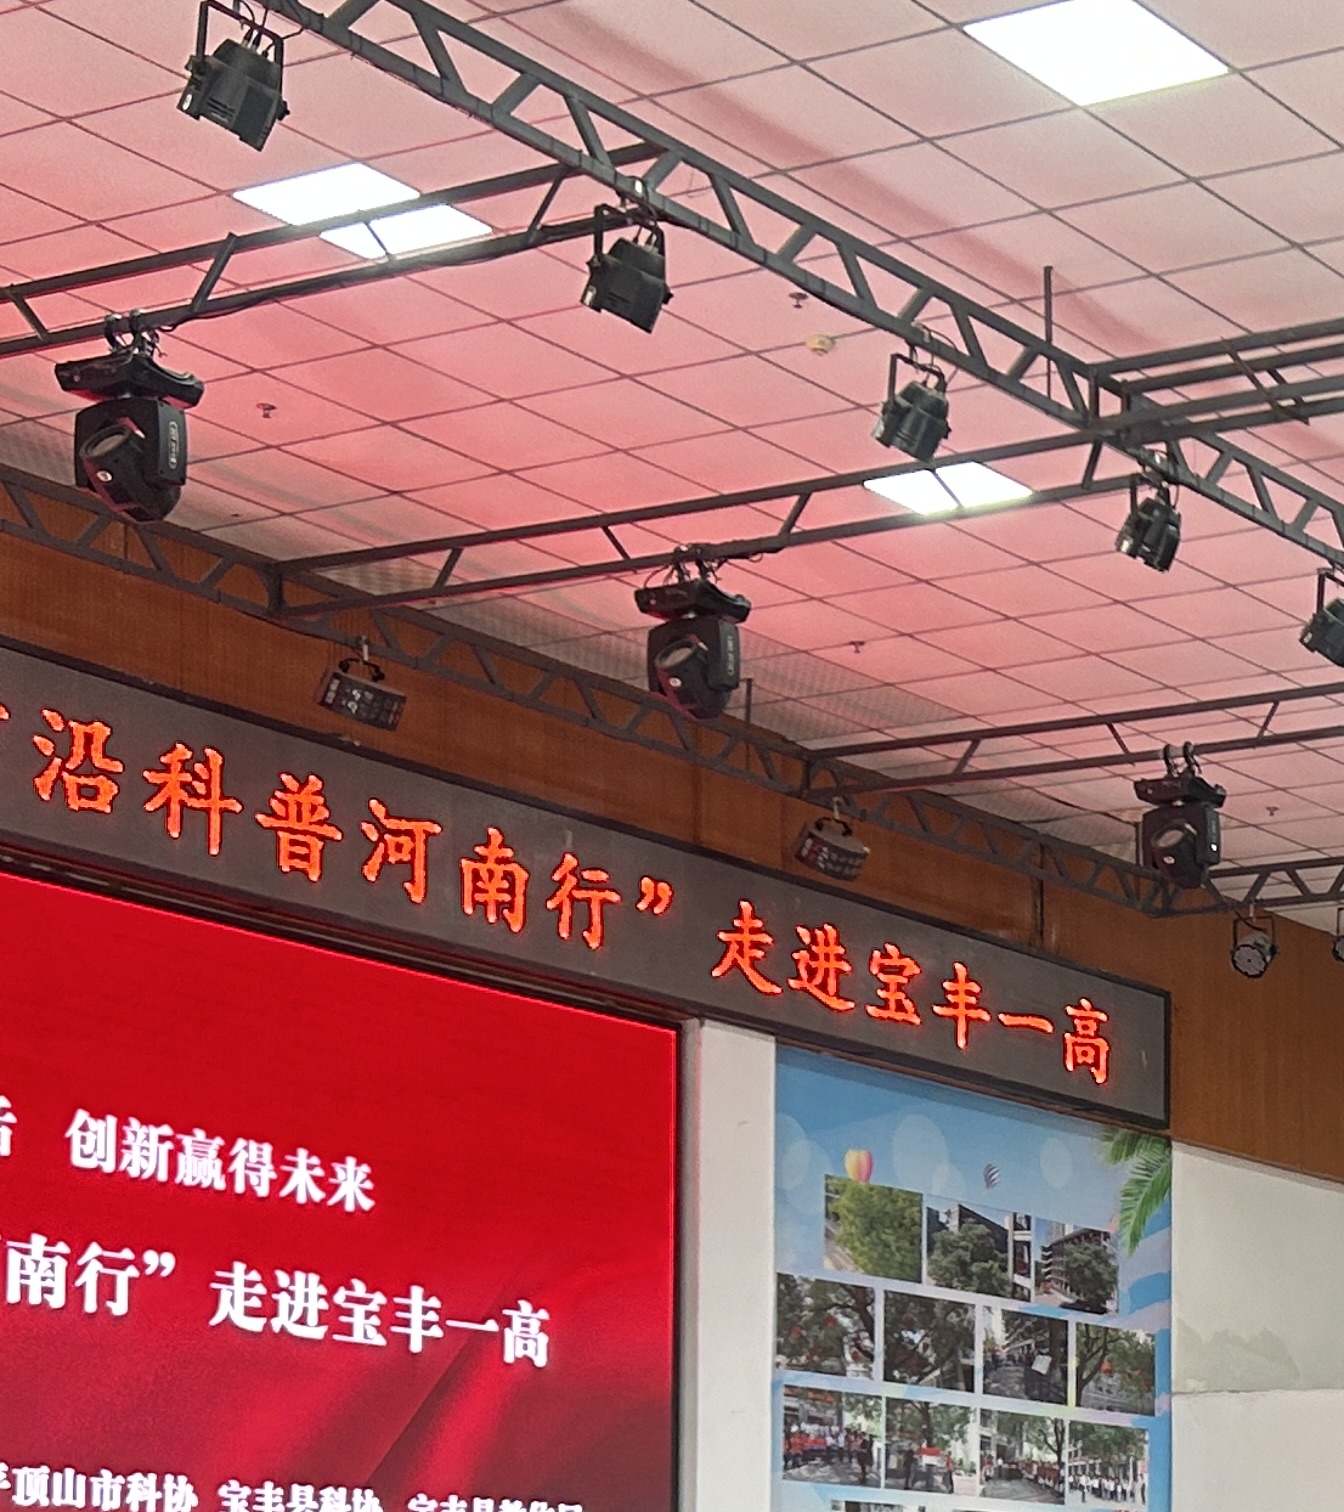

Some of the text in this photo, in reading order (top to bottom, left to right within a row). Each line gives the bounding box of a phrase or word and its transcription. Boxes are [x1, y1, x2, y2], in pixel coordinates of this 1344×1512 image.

[0, 703, 1111, 1085] 沿科普河南行” 走进宝丰一高
[64, 1108, 376, 1213] 创新赢得未来
[4, 1233, 550, 1368] 南行” 走进宝丰一高
